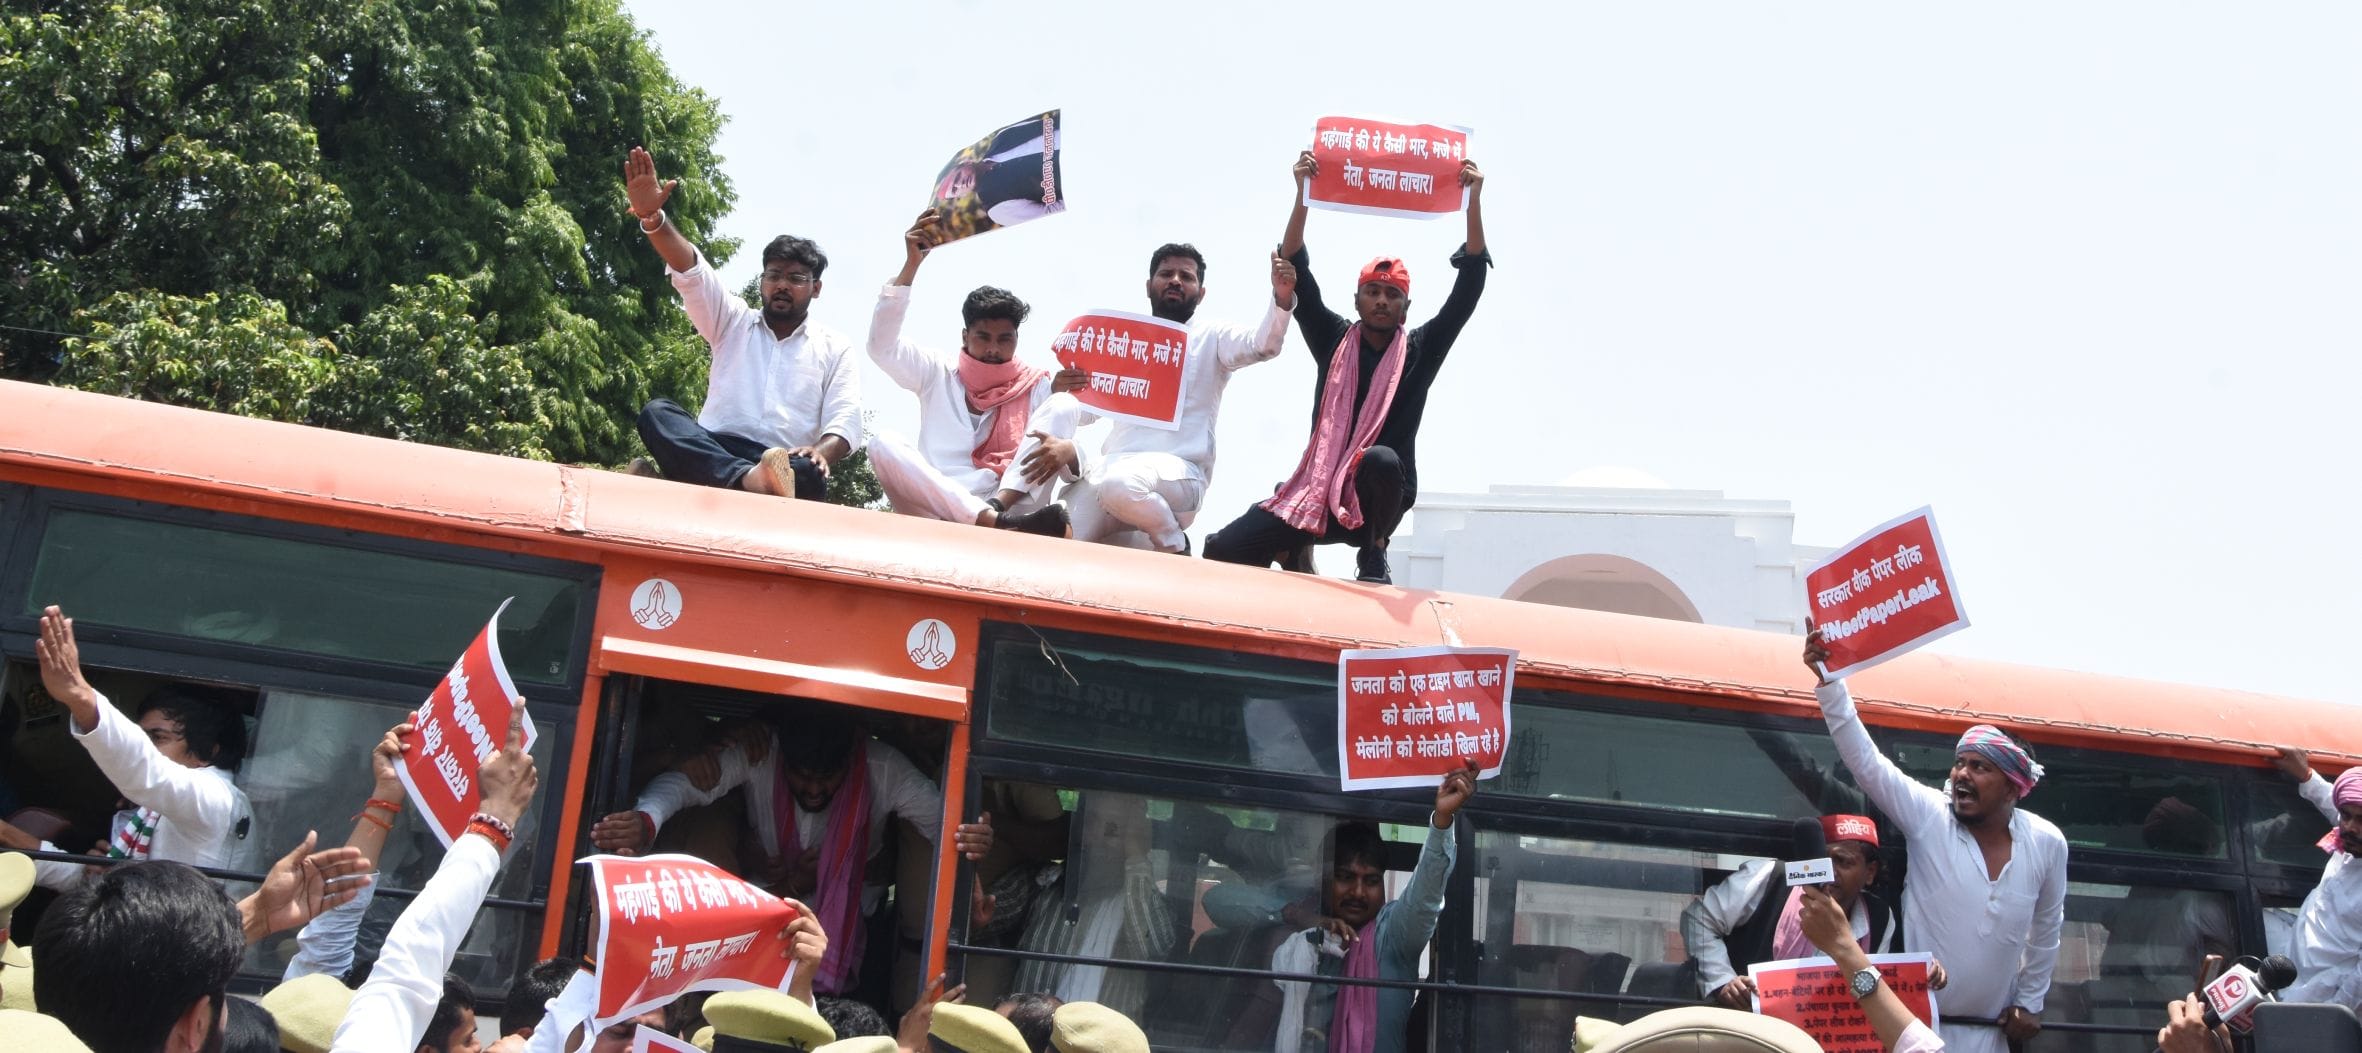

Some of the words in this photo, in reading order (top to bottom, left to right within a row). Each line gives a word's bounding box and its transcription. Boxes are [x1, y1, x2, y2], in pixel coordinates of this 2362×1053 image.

[1321, 126, 1352, 151] महंगाई
[1356, 128, 1370, 151] की
[1372, 131, 1382, 153] ये
[1384, 132, 1407, 154] कैसी
[1409, 138, 1429, 160] मार,
[1432, 137, 1450, 160] मजे
[1452, 141, 1463, 161] में
[1343, 159, 1365, 191] नेता,
[1368, 167, 1398, 191] जनता
[1400, 171, 1434, 195] लाचार।
[1081, 326, 1096, 353] की
[1096, 327, 1106, 355] ये
[1107, 329, 1130, 358] कैसी
[1131, 339, 1149, 365] मार,
[1152, 338, 1172, 366] मजे
[1172, 340, 1183, 368] में
[1091, 371, 1118, 394] जनता
[1118, 375, 1151, 400] लाचार।
[1817, 580, 1854, 609] सरकार
[1851, 568, 1872, 593] वीक
[1870, 558, 1896, 582] पेपर
[1894, 544, 1923, 571] लीक
[1820, 576, 1941, 645] #NeetPaperLeak
[1351, 676, 1386, 695] जनता
[1389, 670, 1406, 694] को
[1410, 674, 1426, 697] एक
[1428, 672, 1451, 692] टाइम
[1453, 670, 1475, 689] खाना
[1477, 664, 1502, 687] खाने
[1382, 703, 1399, 726] को
[1402, 702, 1434, 726] बोलने
[1436, 699, 1456, 724] वाले
[1457, 702, 1480, 725] PM,
[1356, 736, 1393, 760] मेलोनी
[1396, 735, 1413, 759] को
[1417, 734, 1453, 758] मेलोडी
[1455, 731, 1479, 756] खिला
[1481, 728, 1492, 755] रहे
[434, 744, 470, 803] सरकार
[613, 869, 661, 925] महंगाई
[658, 868, 683, 914] की
[677, 868, 698, 910] ये
[693, 869, 729, 909] कैसी
[650, 935, 677, 981] नेता,
[681, 939, 722, 972] जनता
